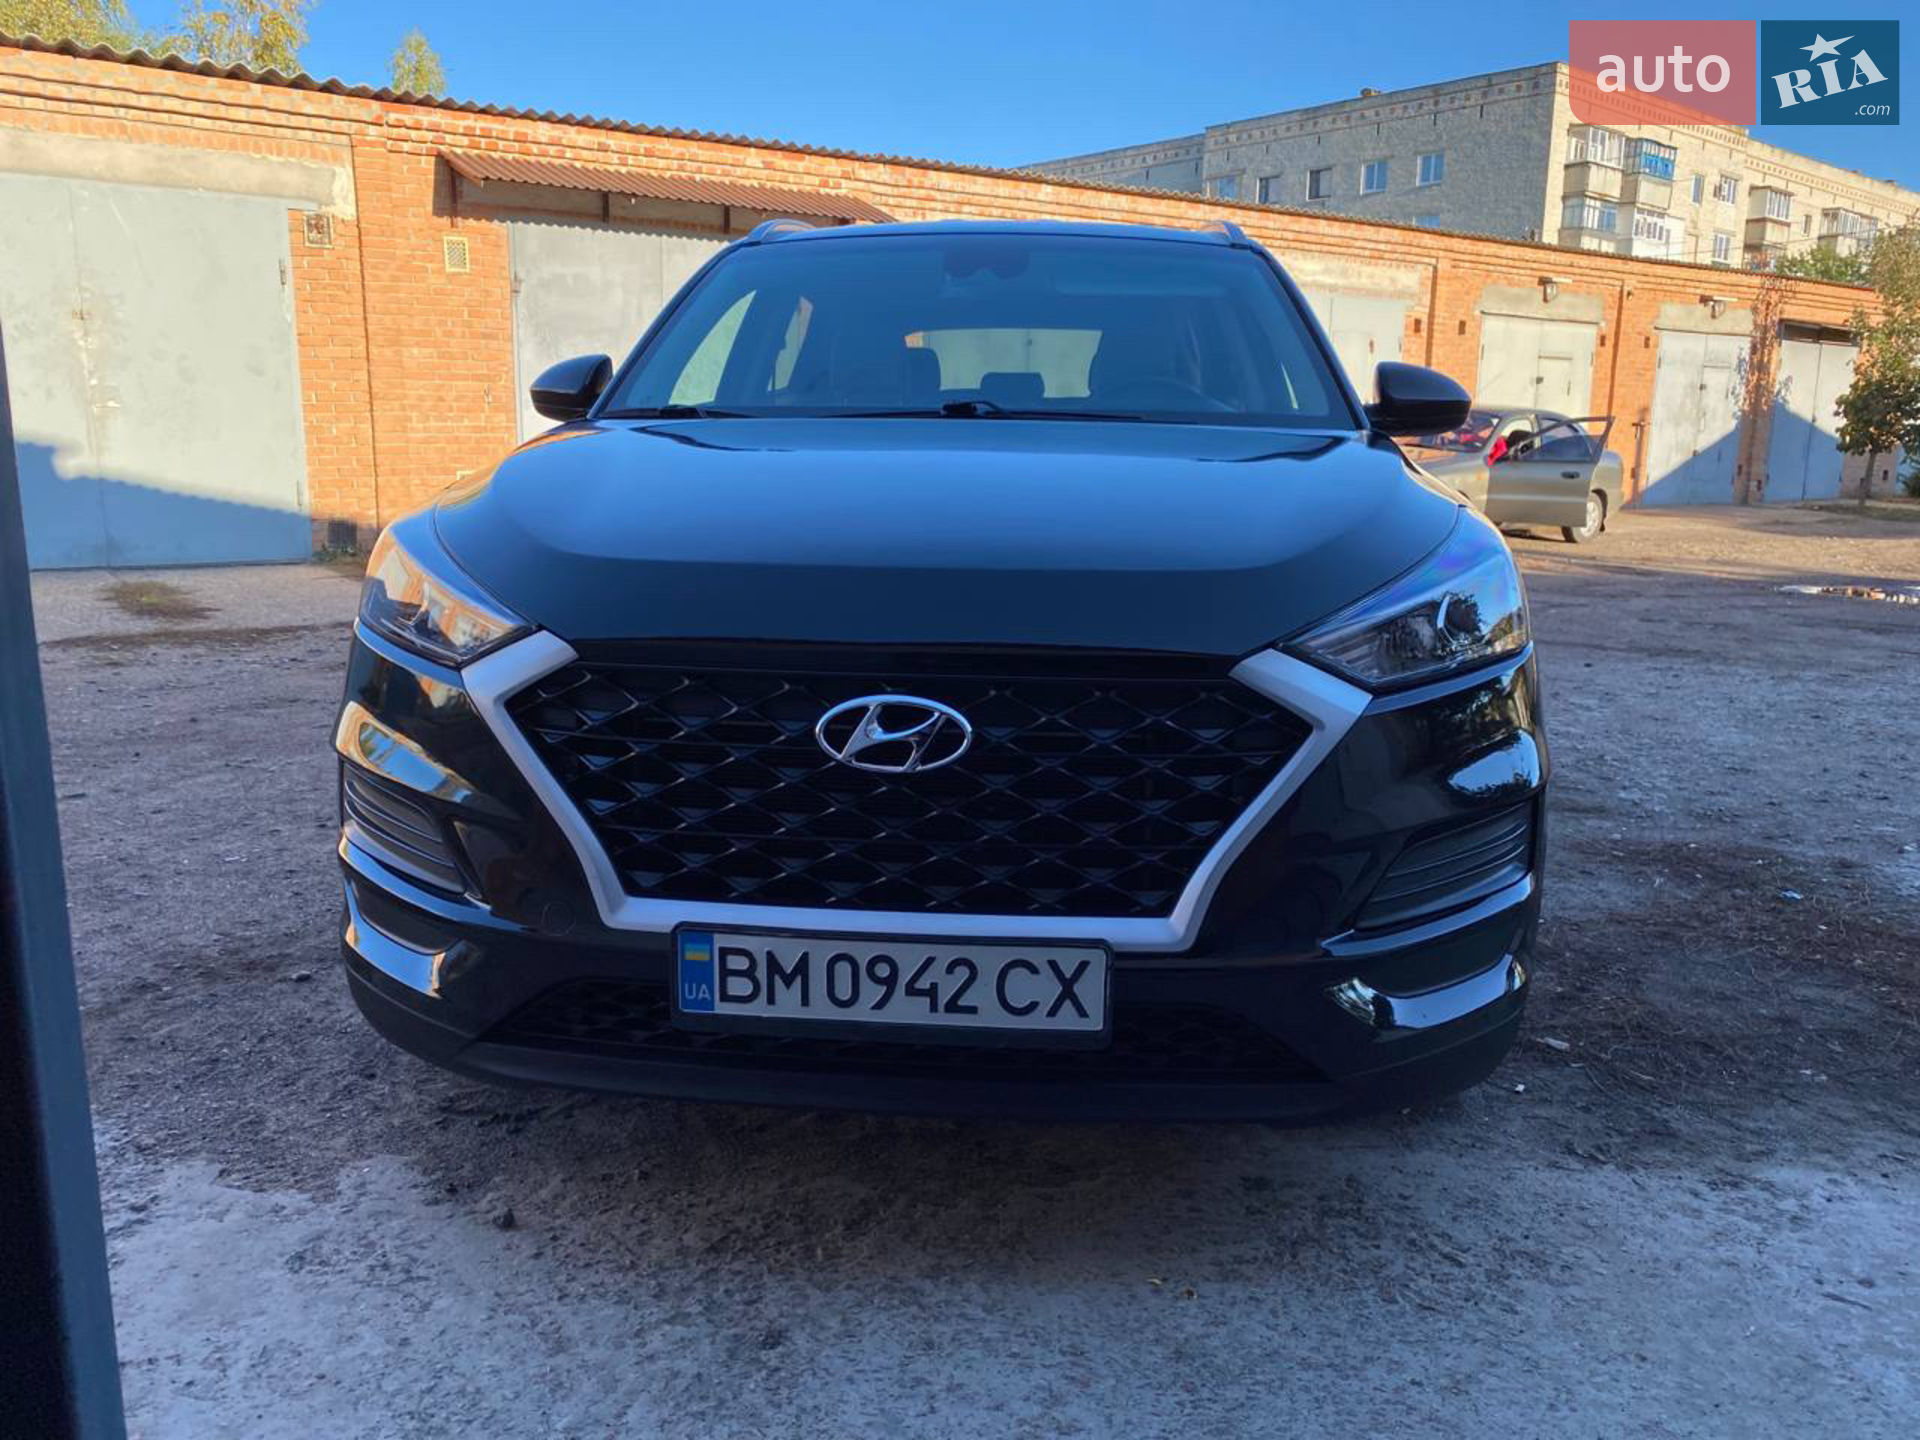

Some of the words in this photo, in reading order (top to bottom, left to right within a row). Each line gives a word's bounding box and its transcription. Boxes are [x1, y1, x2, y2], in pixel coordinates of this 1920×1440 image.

[684, 984, 711, 1001] UA
[718, 946, 811, 1008] BM
[825, 952, 979, 1015] 0942
[995, 958, 1092, 1019] CX
